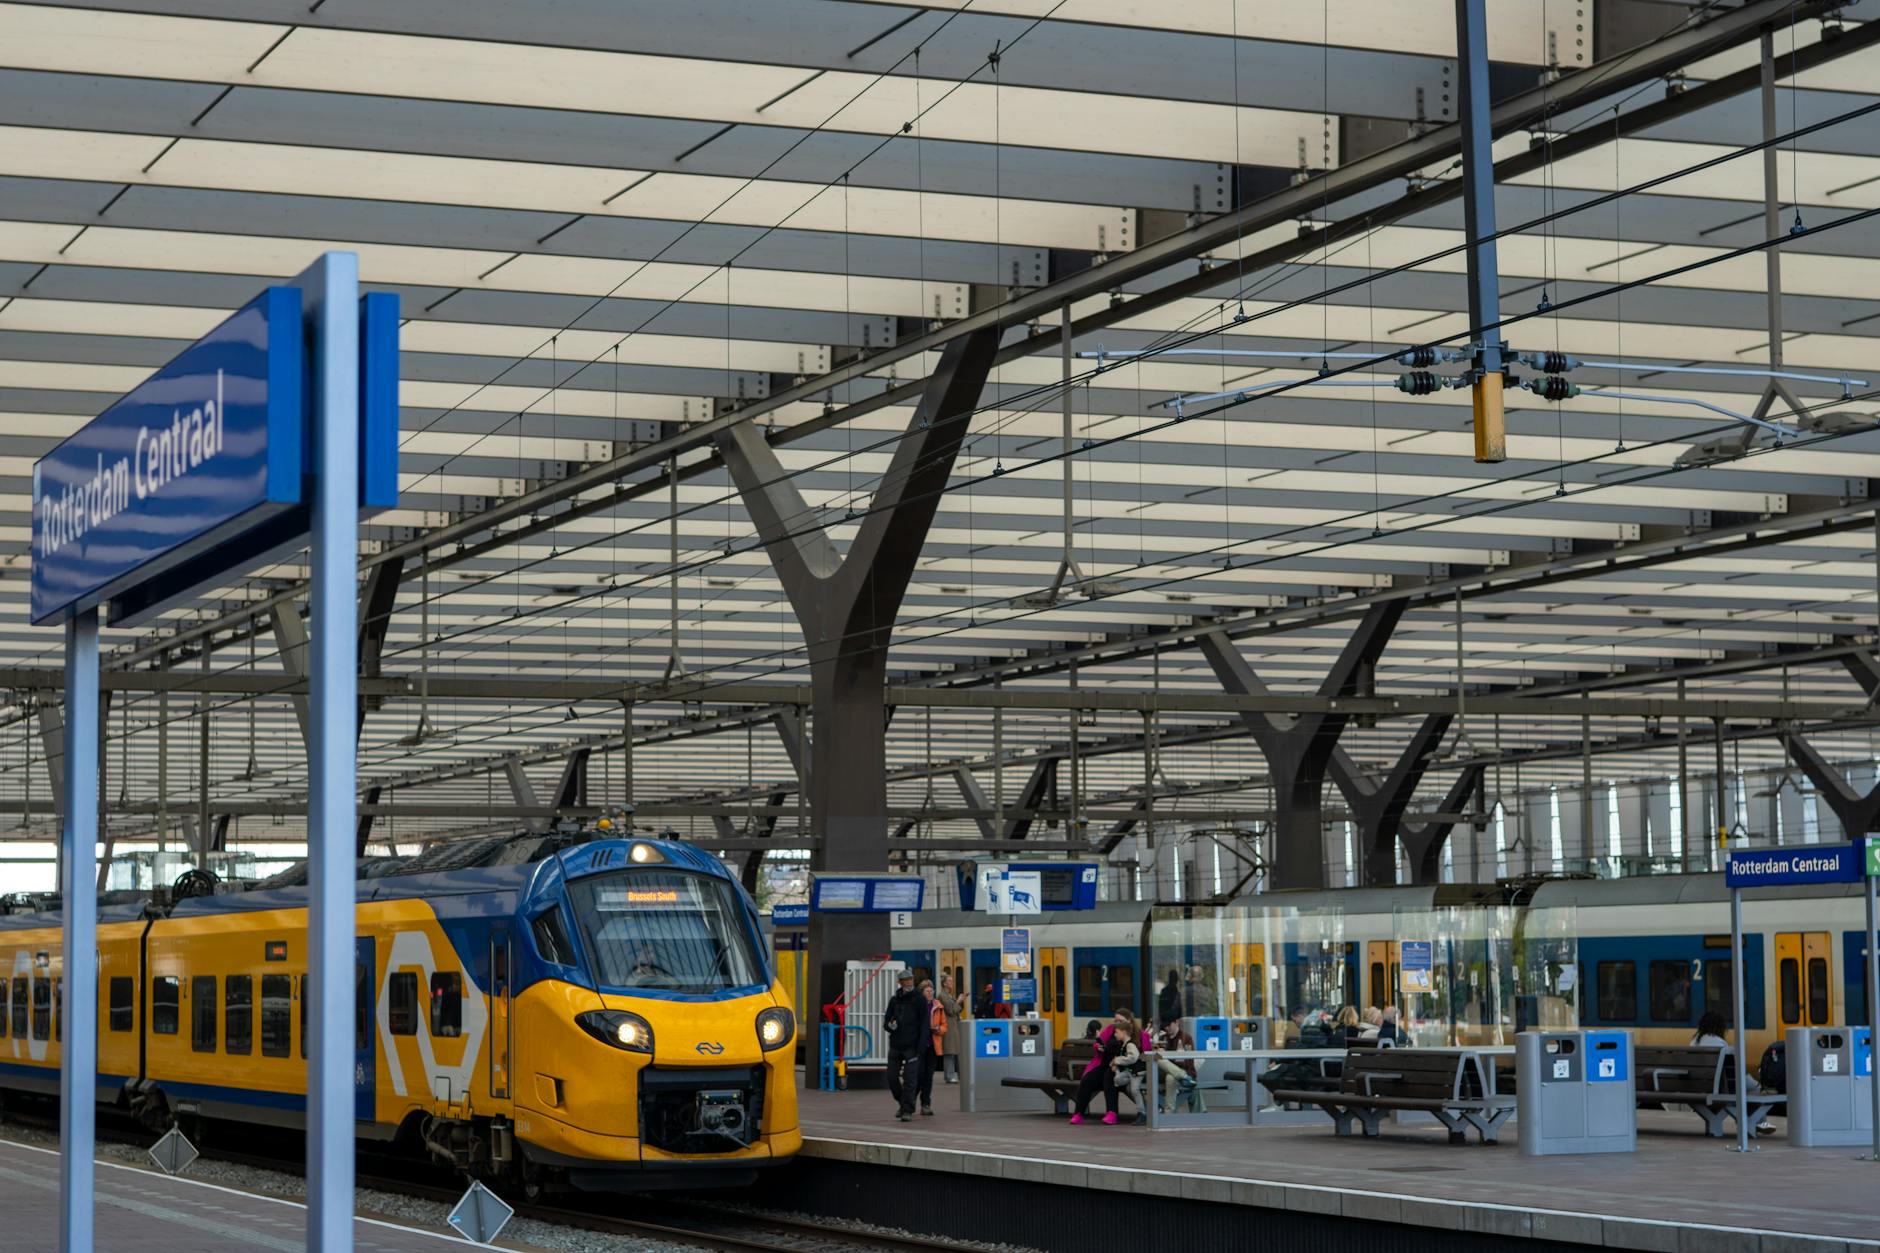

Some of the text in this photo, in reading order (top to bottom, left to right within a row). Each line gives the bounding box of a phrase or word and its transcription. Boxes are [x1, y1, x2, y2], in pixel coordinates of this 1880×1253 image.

[40, 368, 223, 559] Rotterdam Centraal
[1732, 854, 1839, 875] Rotterdam Centraal
[897, 913, 905, 925] E
[1101, 965, 1108, 981] 2
[1457, 961, 1465, 980] 2
[1692, 959, 1702, 980] 2
